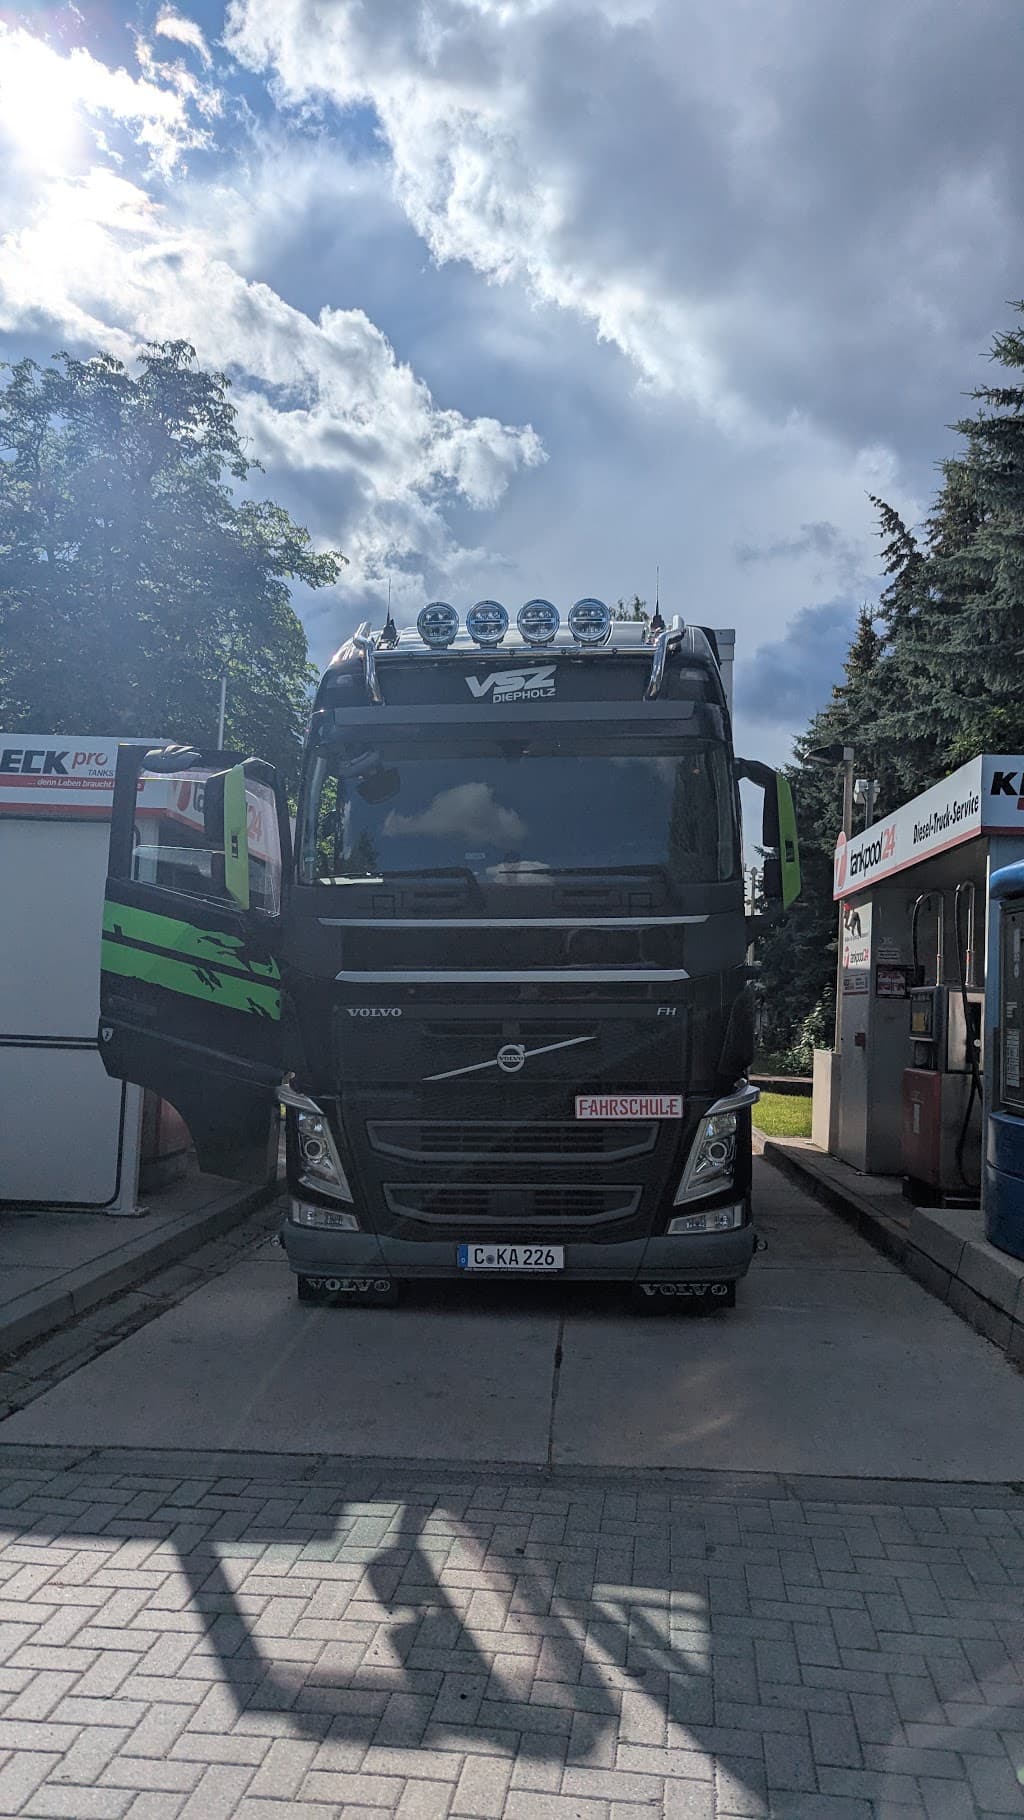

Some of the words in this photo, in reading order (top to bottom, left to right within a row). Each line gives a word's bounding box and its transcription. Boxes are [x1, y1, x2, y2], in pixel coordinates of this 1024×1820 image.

[464, 664, 557, 698] VSZ
[493, 687, 556, 704] DIEPHOLZ
[71, 751, 108, 769] pro
[58, 779, 81, 788] Leben
[990, 771, 1024, 796] K
[850, 823, 897, 877] tankpool24
[913, 790, 980, 844] Diesel-Truck-Service
[345, 1008, 402, 1017] VOLVO
[657, 1007, 677, 1016] FH
[579, 1099, 680, 1116] FAHRSCHULE
[474, 1248, 485, 1265] C
[497, 1248, 519, 1265] KA
[523, 1248, 555, 1266] 226
[305, 1278, 391, 1292] VOLVO
[640, 1283, 728, 1296] VOLVO
